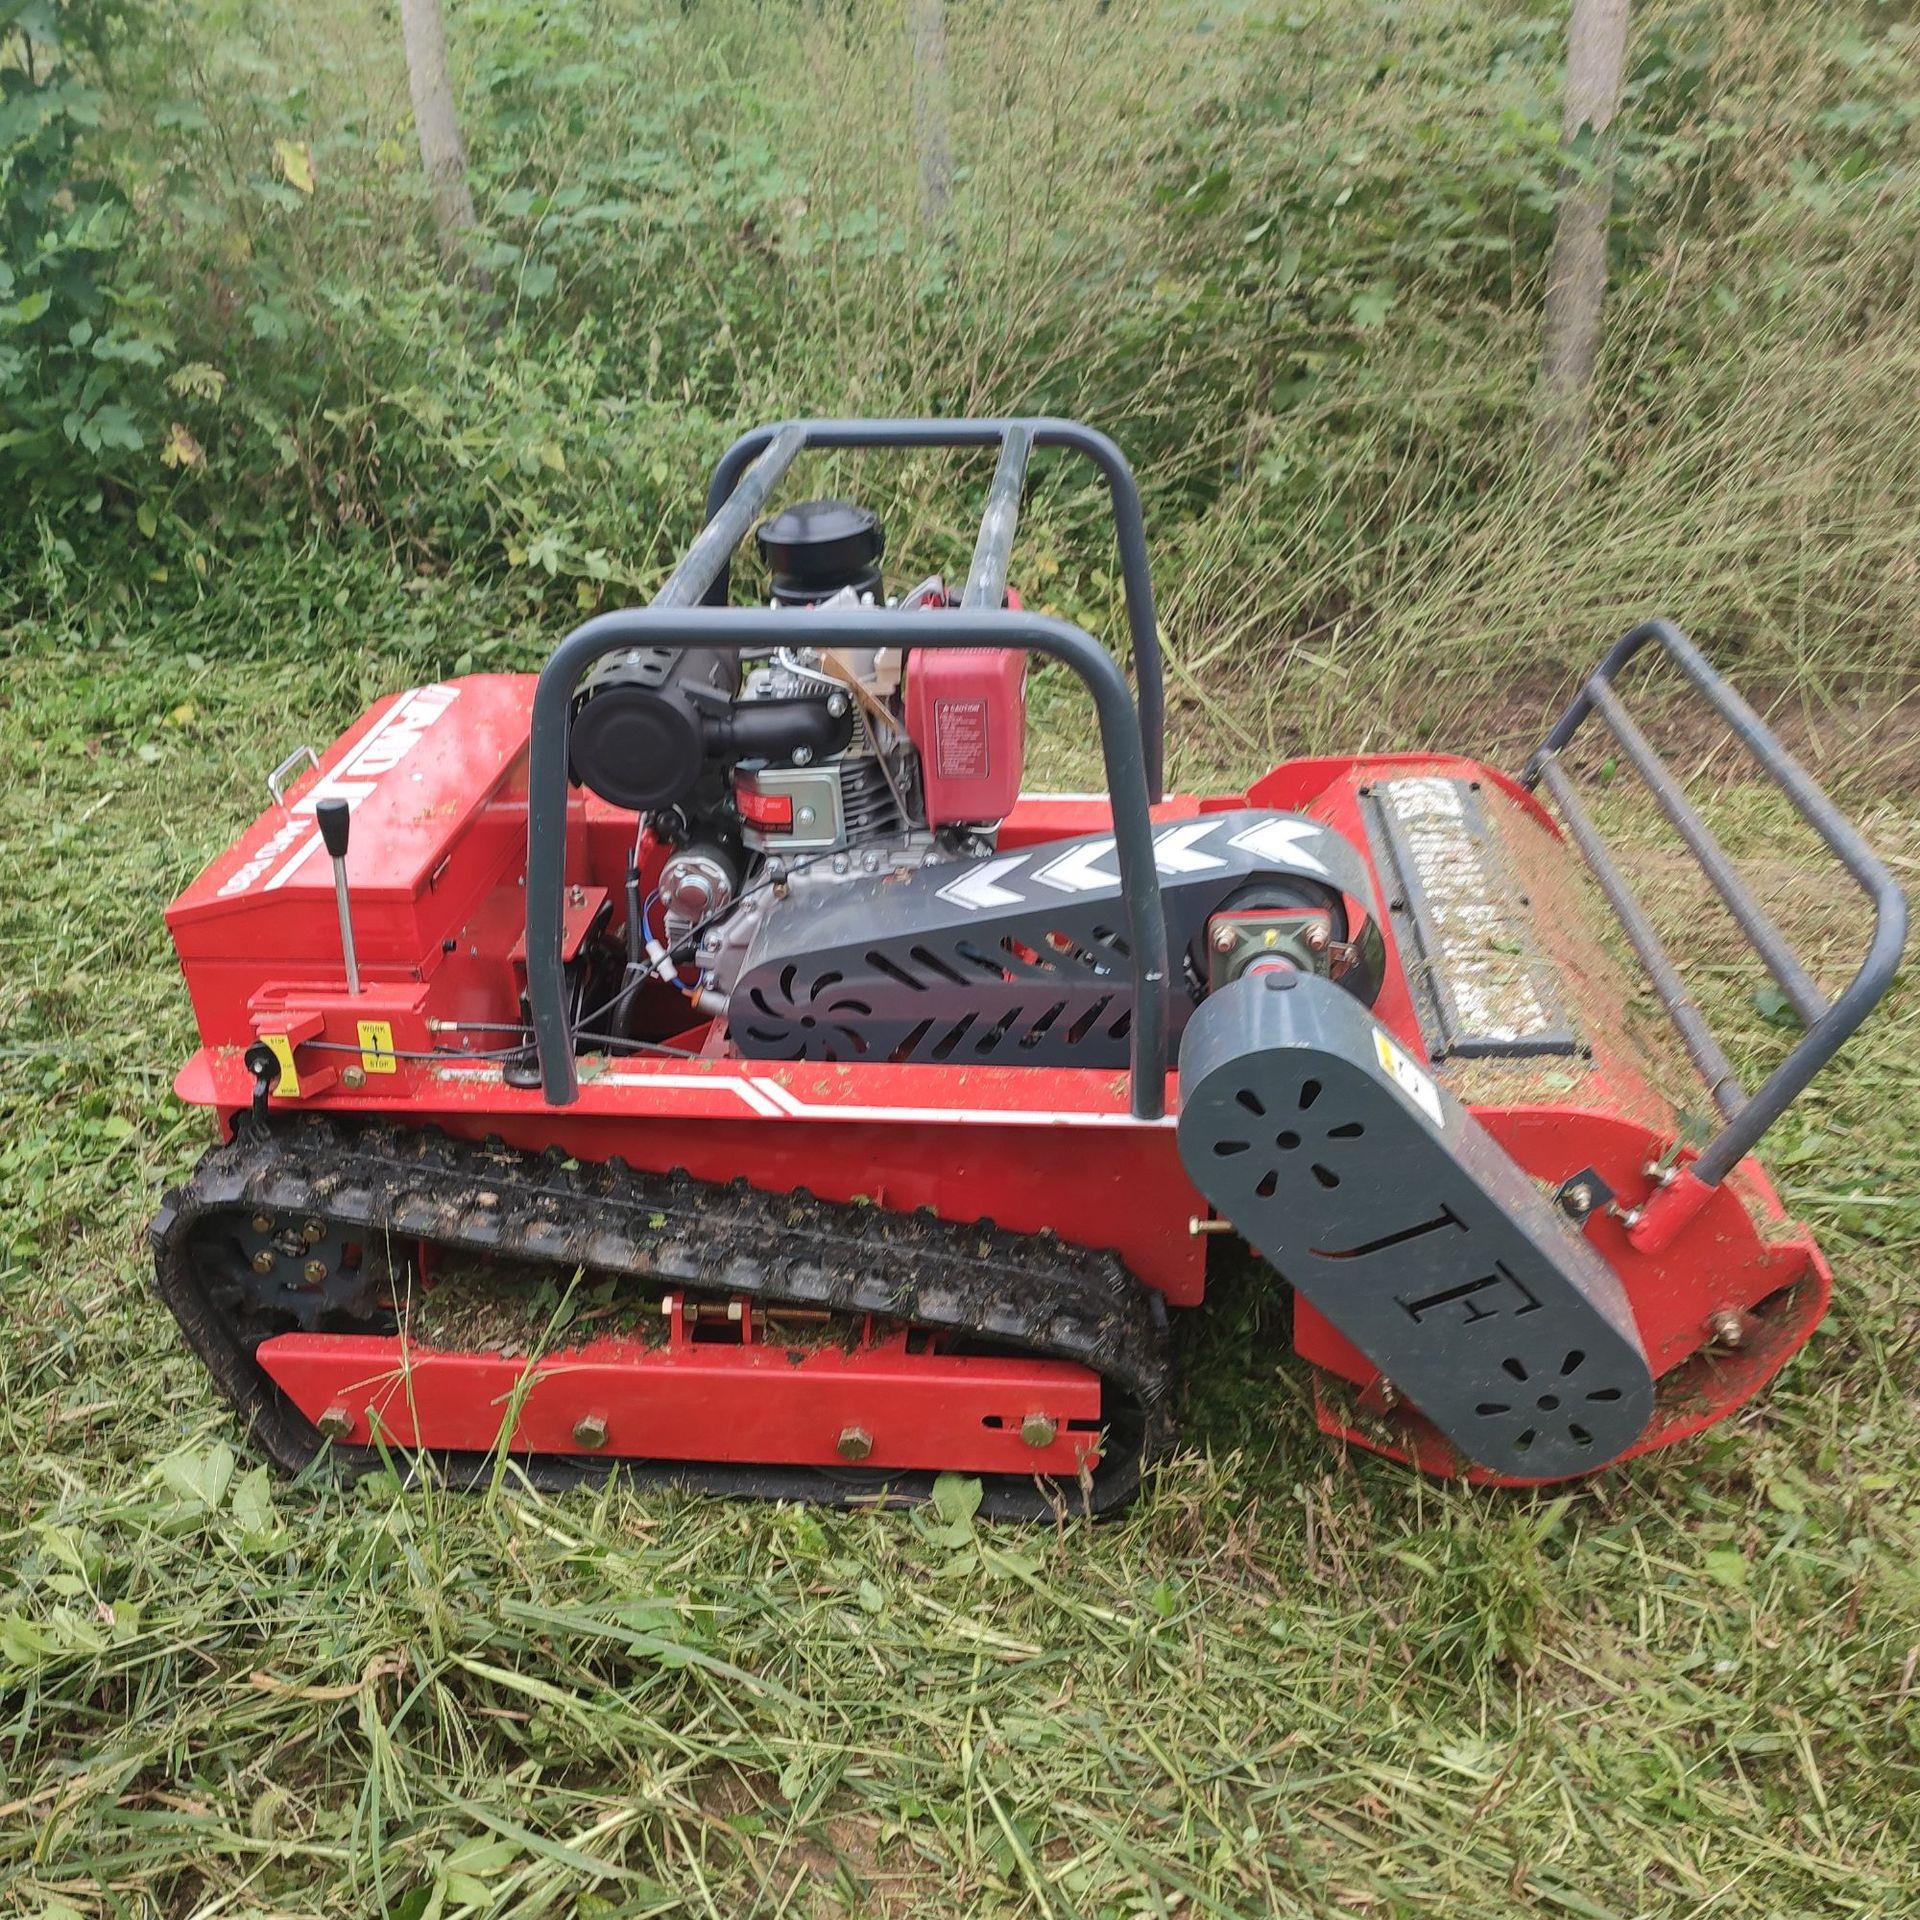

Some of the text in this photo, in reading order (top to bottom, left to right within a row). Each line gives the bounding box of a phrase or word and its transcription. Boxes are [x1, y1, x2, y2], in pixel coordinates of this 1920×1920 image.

[362, 1024, 385, 1033] WORK
[369, 1060, 389, 1069] STOP
[1308, 1202, 1544, 1325] JF
